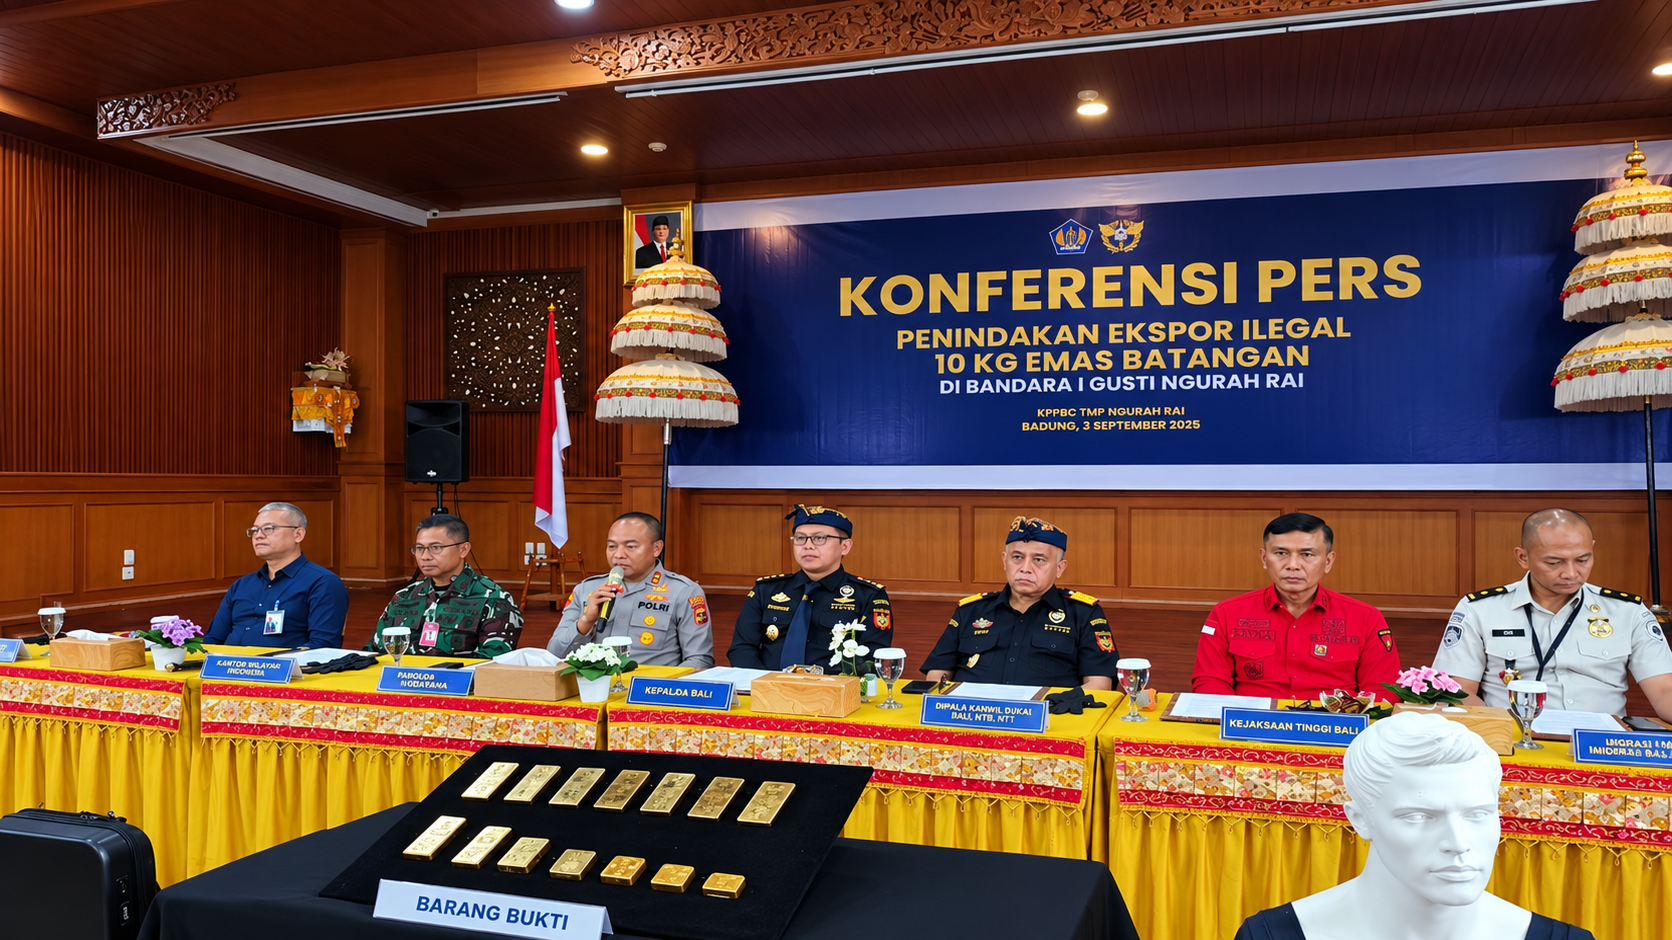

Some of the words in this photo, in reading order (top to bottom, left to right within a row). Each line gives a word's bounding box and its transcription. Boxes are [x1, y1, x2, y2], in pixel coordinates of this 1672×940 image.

[839, 261, 1238, 317] KONFERENSI
[1258, 254, 1422, 303] PERS
[897, 323, 1099, 350] PENINDAKAN
[1108, 319, 1234, 344] EKSPOR
[1242, 316, 1352, 341] ILEGAL
[934, 353, 966, 375] 10
[974, 352, 1018, 374] KG
[1026, 349, 1114, 373] EMAS
[1122, 345, 1310, 370] BATANGAN
[940, 379, 960, 394] DI
[966, 377, 1073, 394] BANDARA
[1078, 377, 1084, 392] I
[1089, 375, 1155, 392] GUSTI
[1161, 373, 1260, 391] NGURAH
[1266, 372, 1304, 389] RAI
[1037, 408, 1077, 418] KPPBC
[1079, 407, 1105, 417] TMP
[1108, 406, 1161, 417] NGURAH
[1163, 406, 1185, 416] RAI
[1021, 421, 1080, 433] BADUNG,
[1082, 421, 1091, 431] 3
[1093, 420, 1167, 431] SEPTEMBER
[1169, 419, 1201, 430] 2025
[638, 601, 670, 612] POLRI
[690, 689, 713, 699] BALI
[968, 704, 1003, 715] KANWIL
[997, 715, 1015, 723] NTT
[1229, 718, 1293, 731] KEJAKSAAN
[1295, 723, 1332, 733] TINGGI
[1334, 725, 1360, 735] BALI
[416, 895, 501, 922] BARANG
[506, 908, 569, 931] BUKTI
